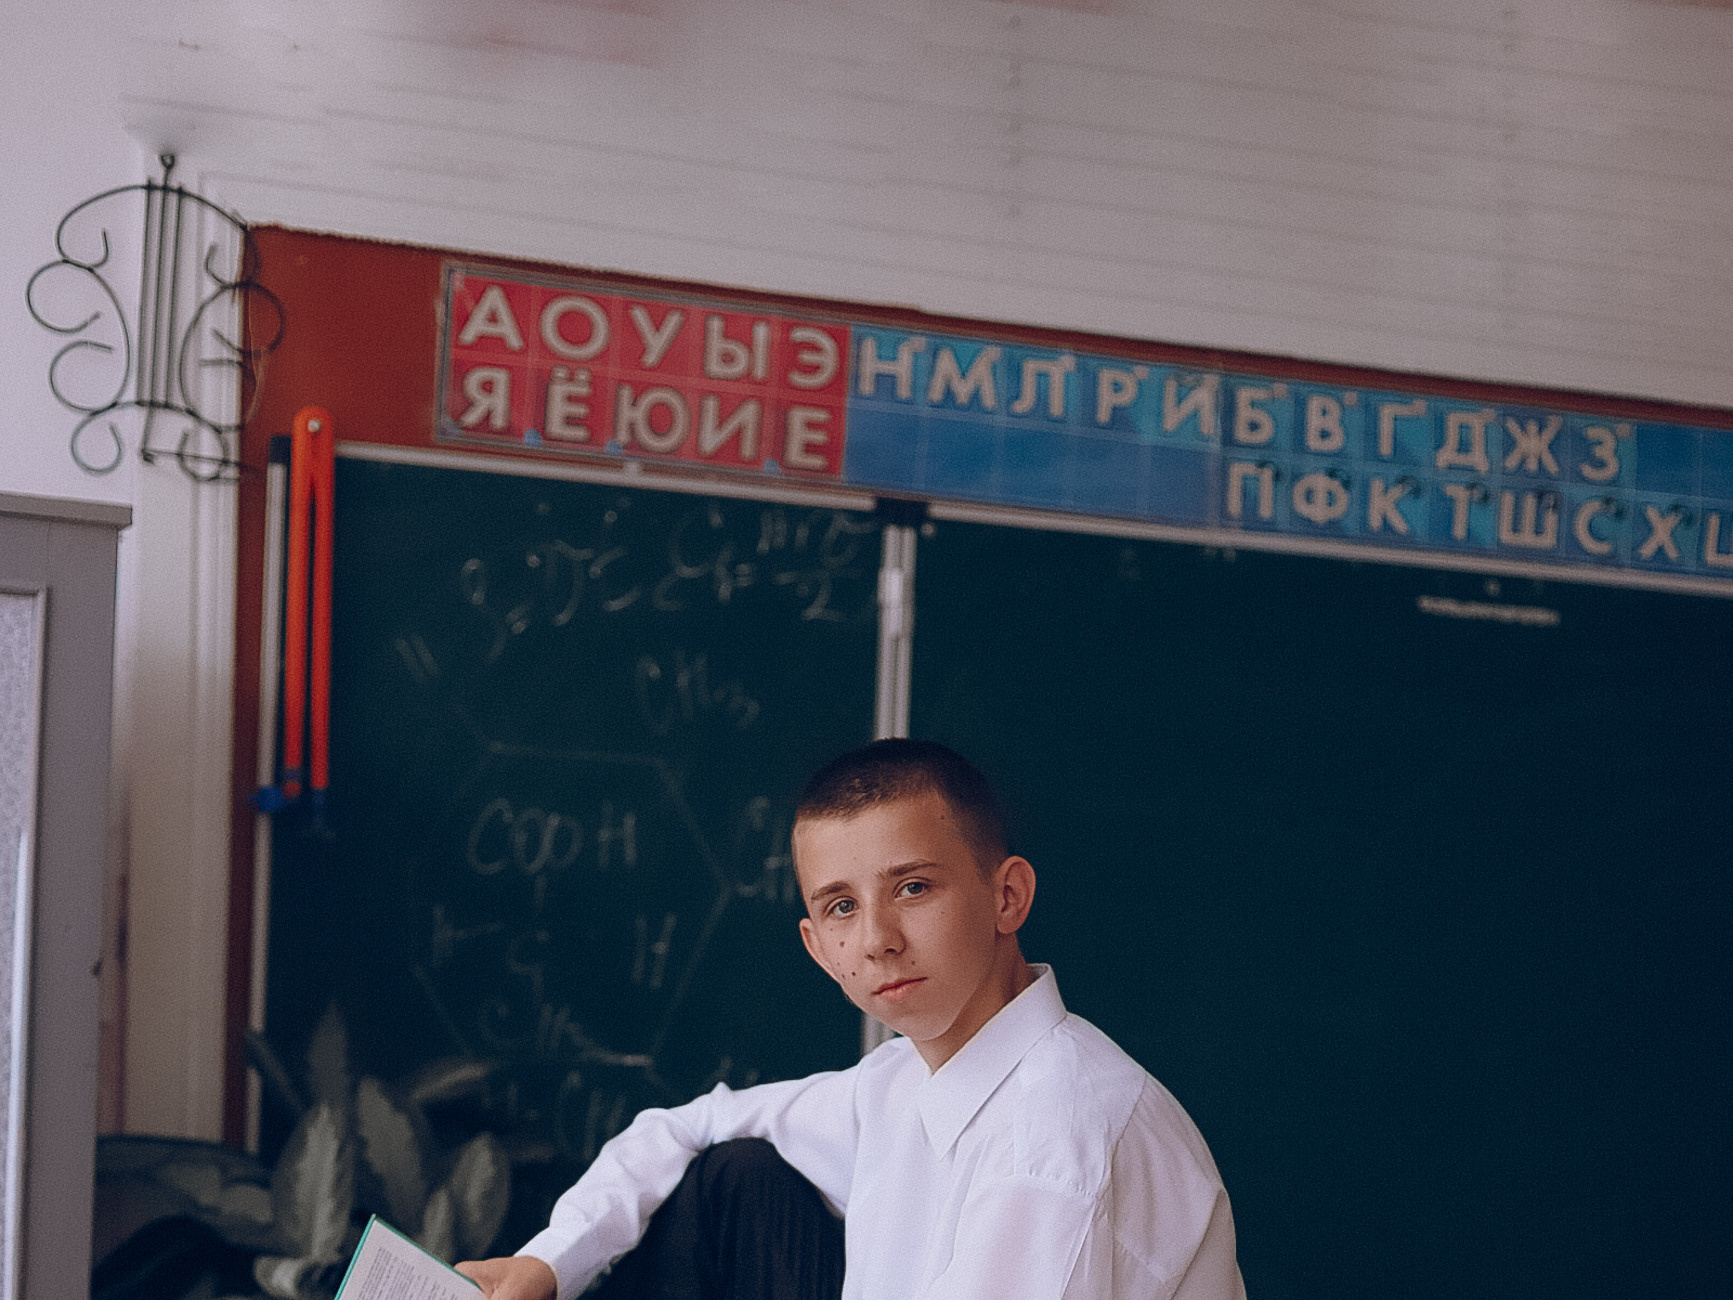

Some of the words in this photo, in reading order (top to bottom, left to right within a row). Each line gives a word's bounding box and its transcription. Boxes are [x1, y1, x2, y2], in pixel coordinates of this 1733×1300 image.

[458, 285, 524, 350] А
[539, 297, 611, 361] О
[628, 304, 685, 368] У
[703, 314, 770, 380] Ы
[789, 327, 839, 389] Э
[460, 367, 512, 430] Я
[544, 365, 593, 443] Ё
[614, 384, 692, 454] Ю
[700, 394, 762, 461] И
[784, 405, 832, 471] Е
